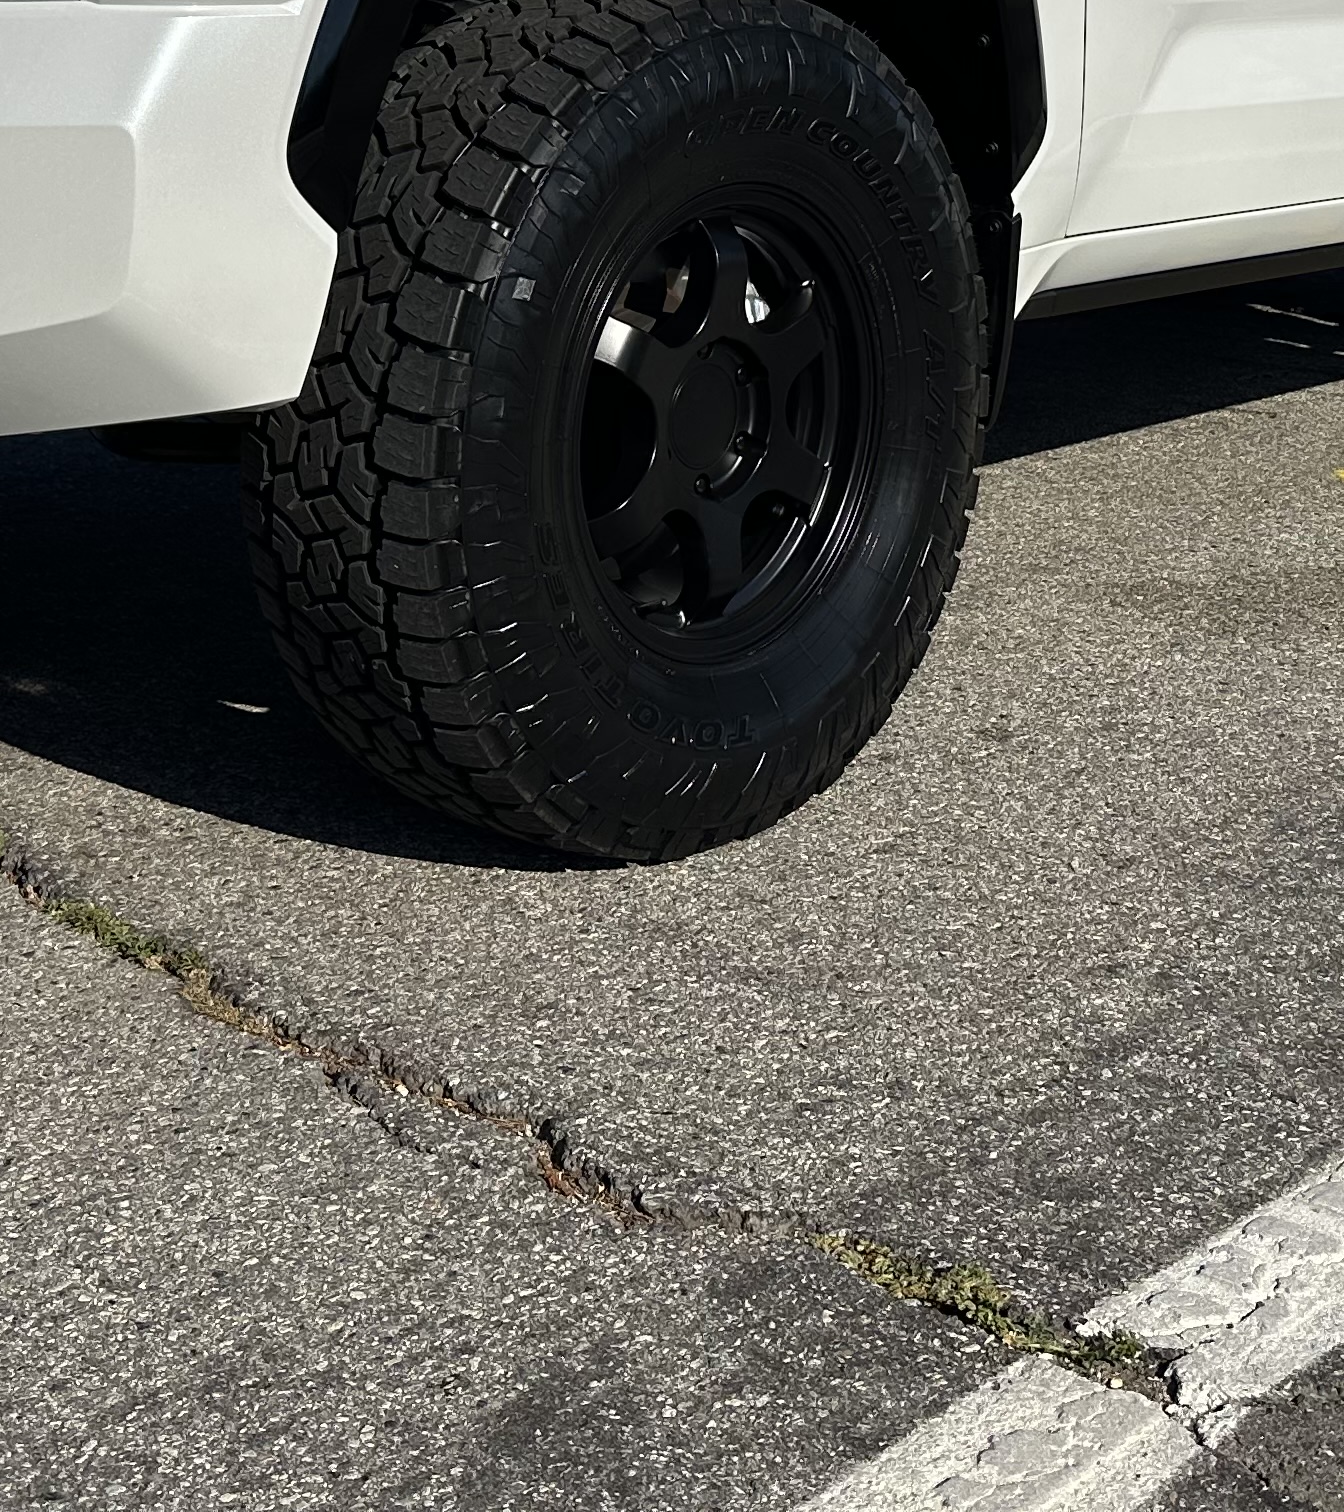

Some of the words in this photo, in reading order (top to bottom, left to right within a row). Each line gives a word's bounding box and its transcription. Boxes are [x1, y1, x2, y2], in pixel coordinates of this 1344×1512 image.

[685, 105, 806, 148] OPEN
[806, 117, 942, 308] COUNTRY
[533, 523, 625, 711] TIRES
